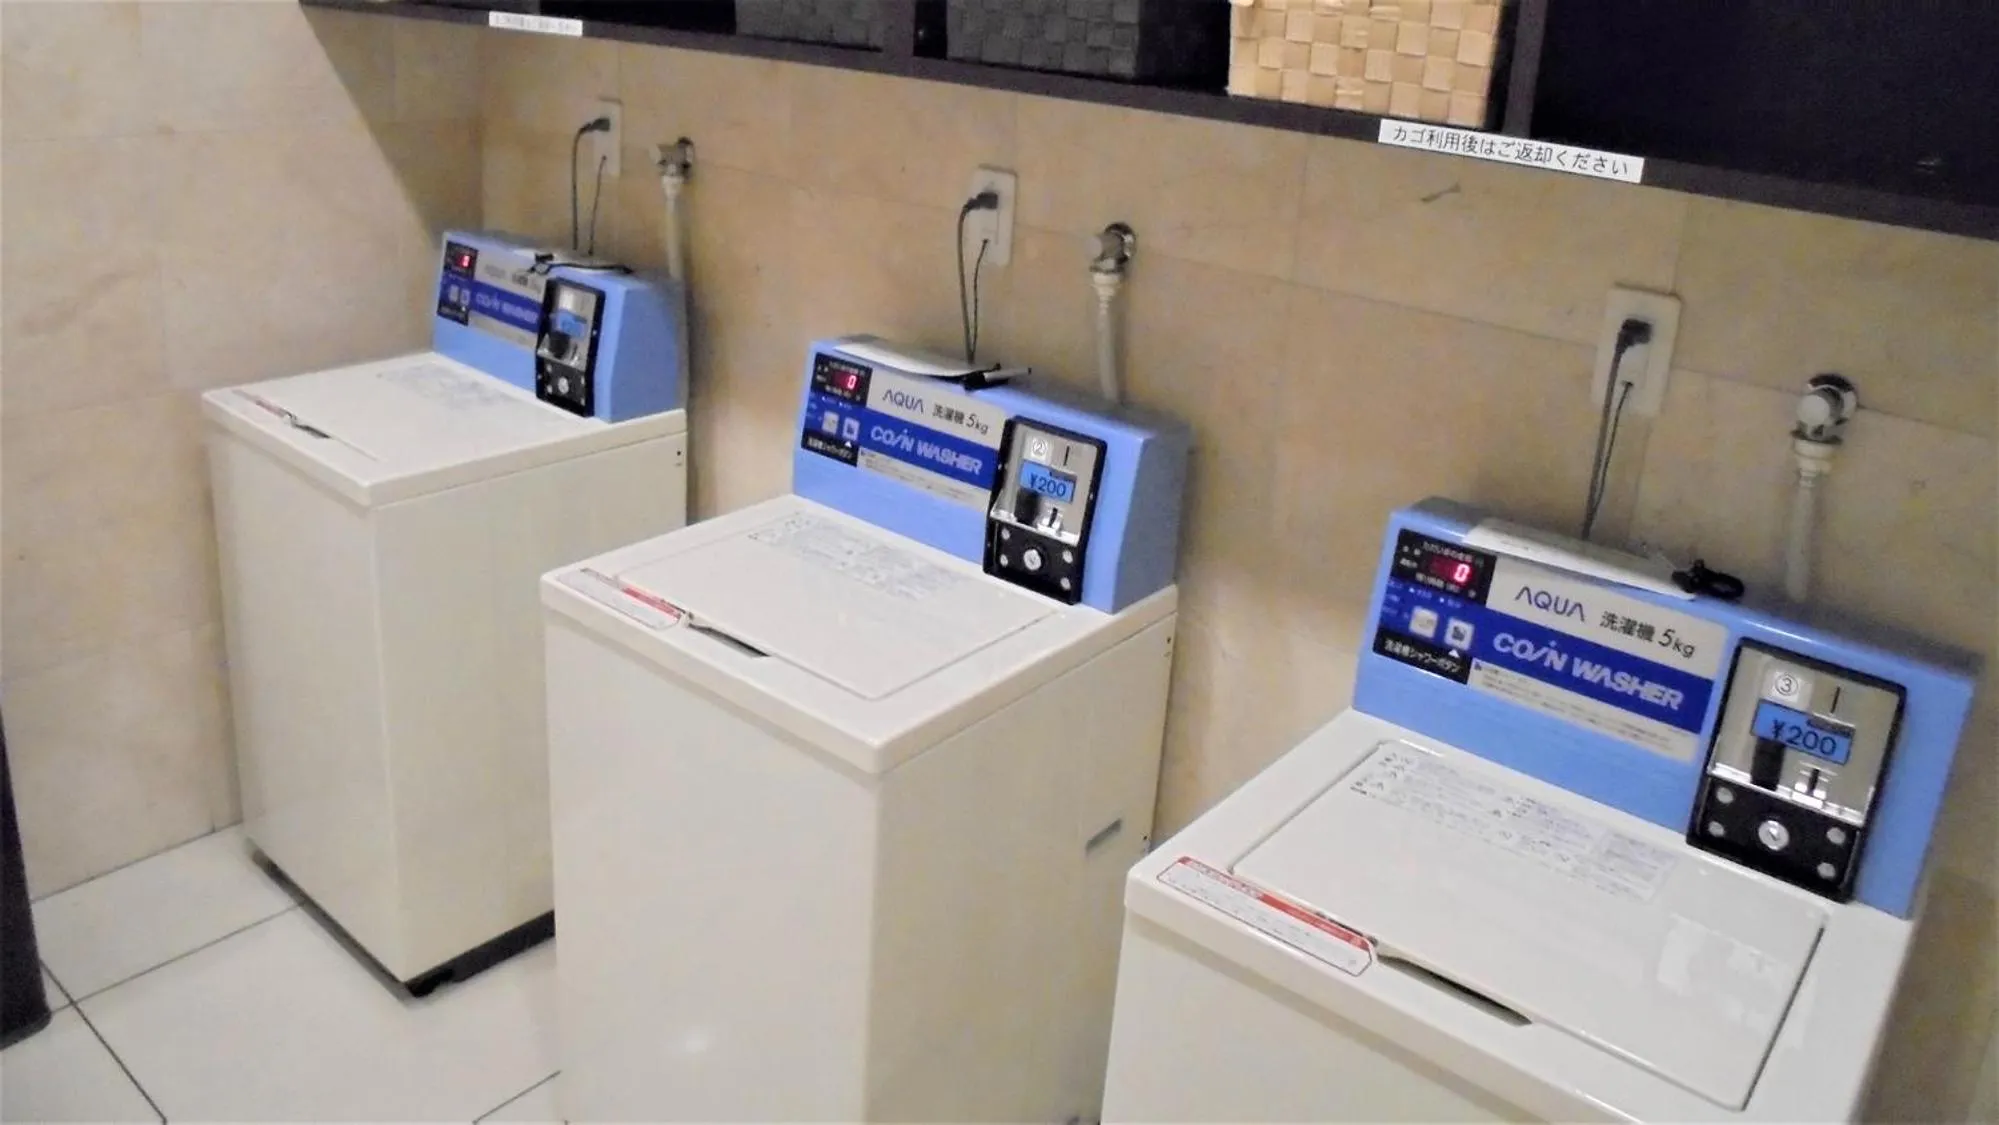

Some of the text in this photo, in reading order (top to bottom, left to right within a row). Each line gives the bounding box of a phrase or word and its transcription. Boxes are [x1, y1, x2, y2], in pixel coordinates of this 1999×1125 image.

[1394, 126, 1628, 176] カゴ利用後はご返却ください
[847, 375, 857, 390] 0
[882, 389, 924, 414] AQUA
[870, 426, 915, 452] COIN
[916, 440, 983, 475] WASHER
[1454, 563, 1471, 583] 0
[1515, 586, 1696, 659] AQUA 洗濯機 5kg
[1493, 632, 1569, 673] COIN
[1571, 657, 1685, 711] WASHER
[1772, 718, 1837, 757] ¥200
